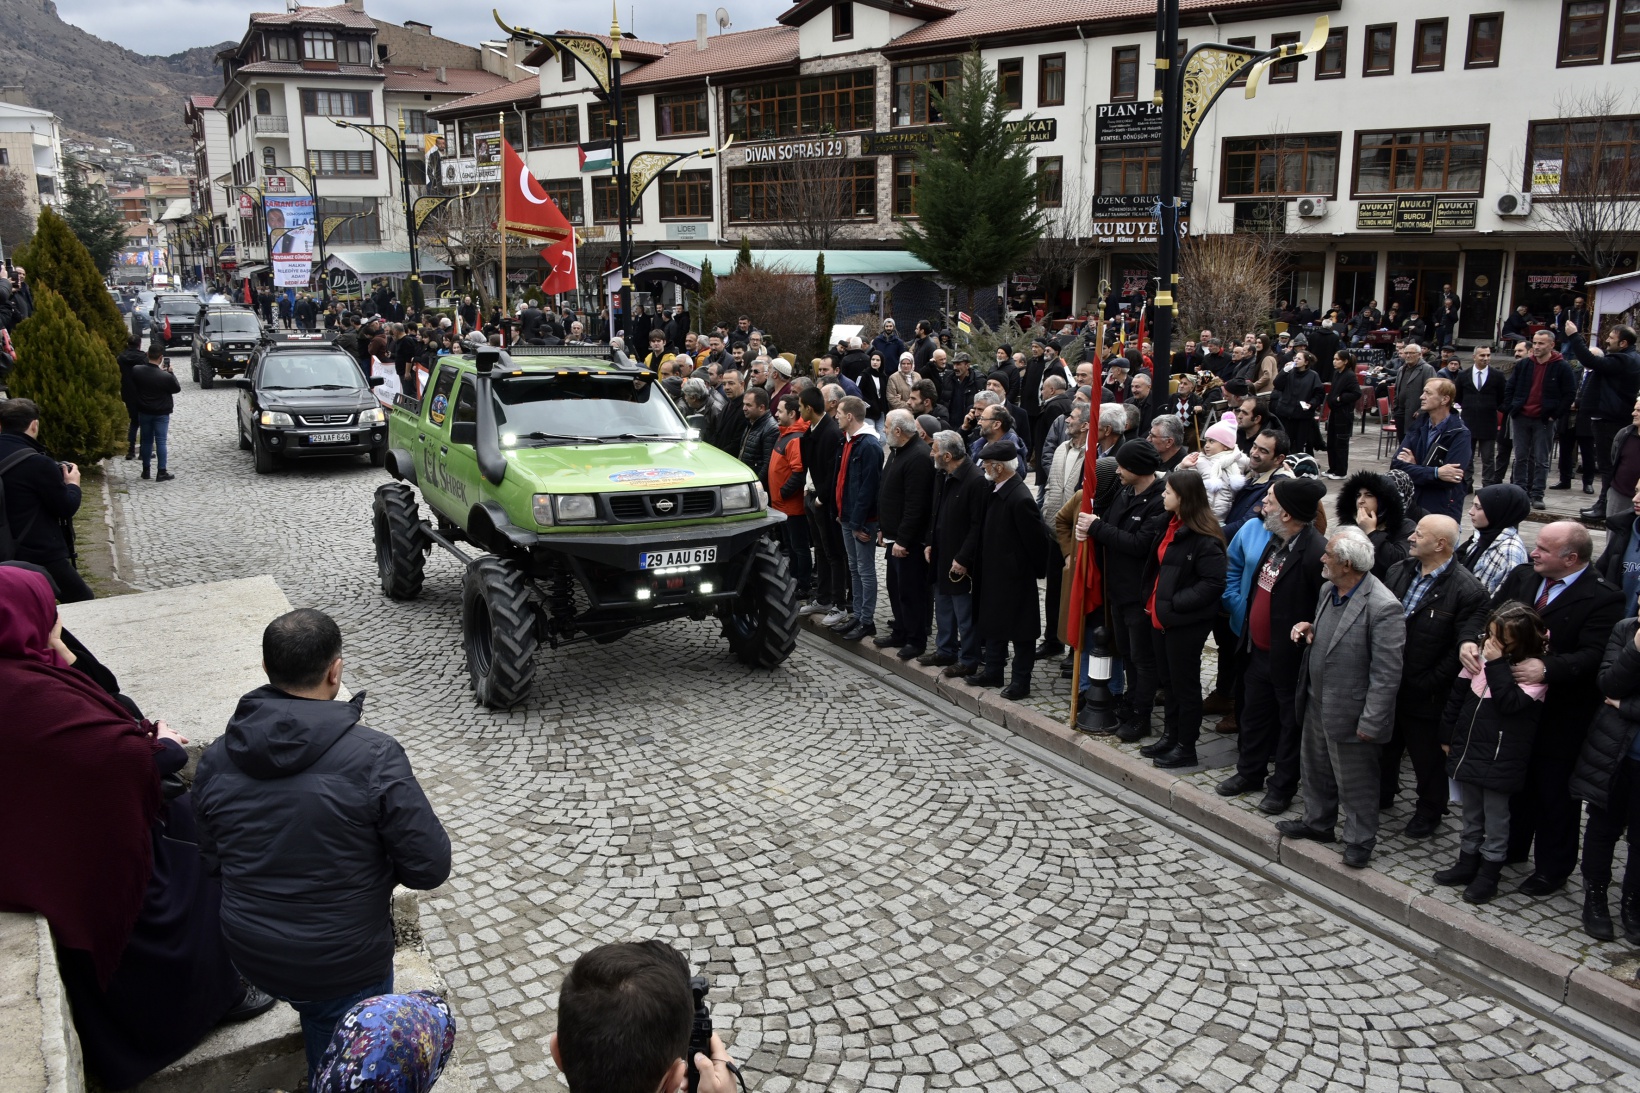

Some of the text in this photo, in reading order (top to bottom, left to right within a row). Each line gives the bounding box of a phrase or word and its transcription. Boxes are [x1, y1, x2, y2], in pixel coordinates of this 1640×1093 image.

[778, 142, 825, 160] SOFRASI
[828, 140, 842, 156] 29
[1097, 196, 1128, 205] ÖZENÇ
[677, 224, 696, 233] LİDER
[647, 549, 716, 567] 29 AAU 619
